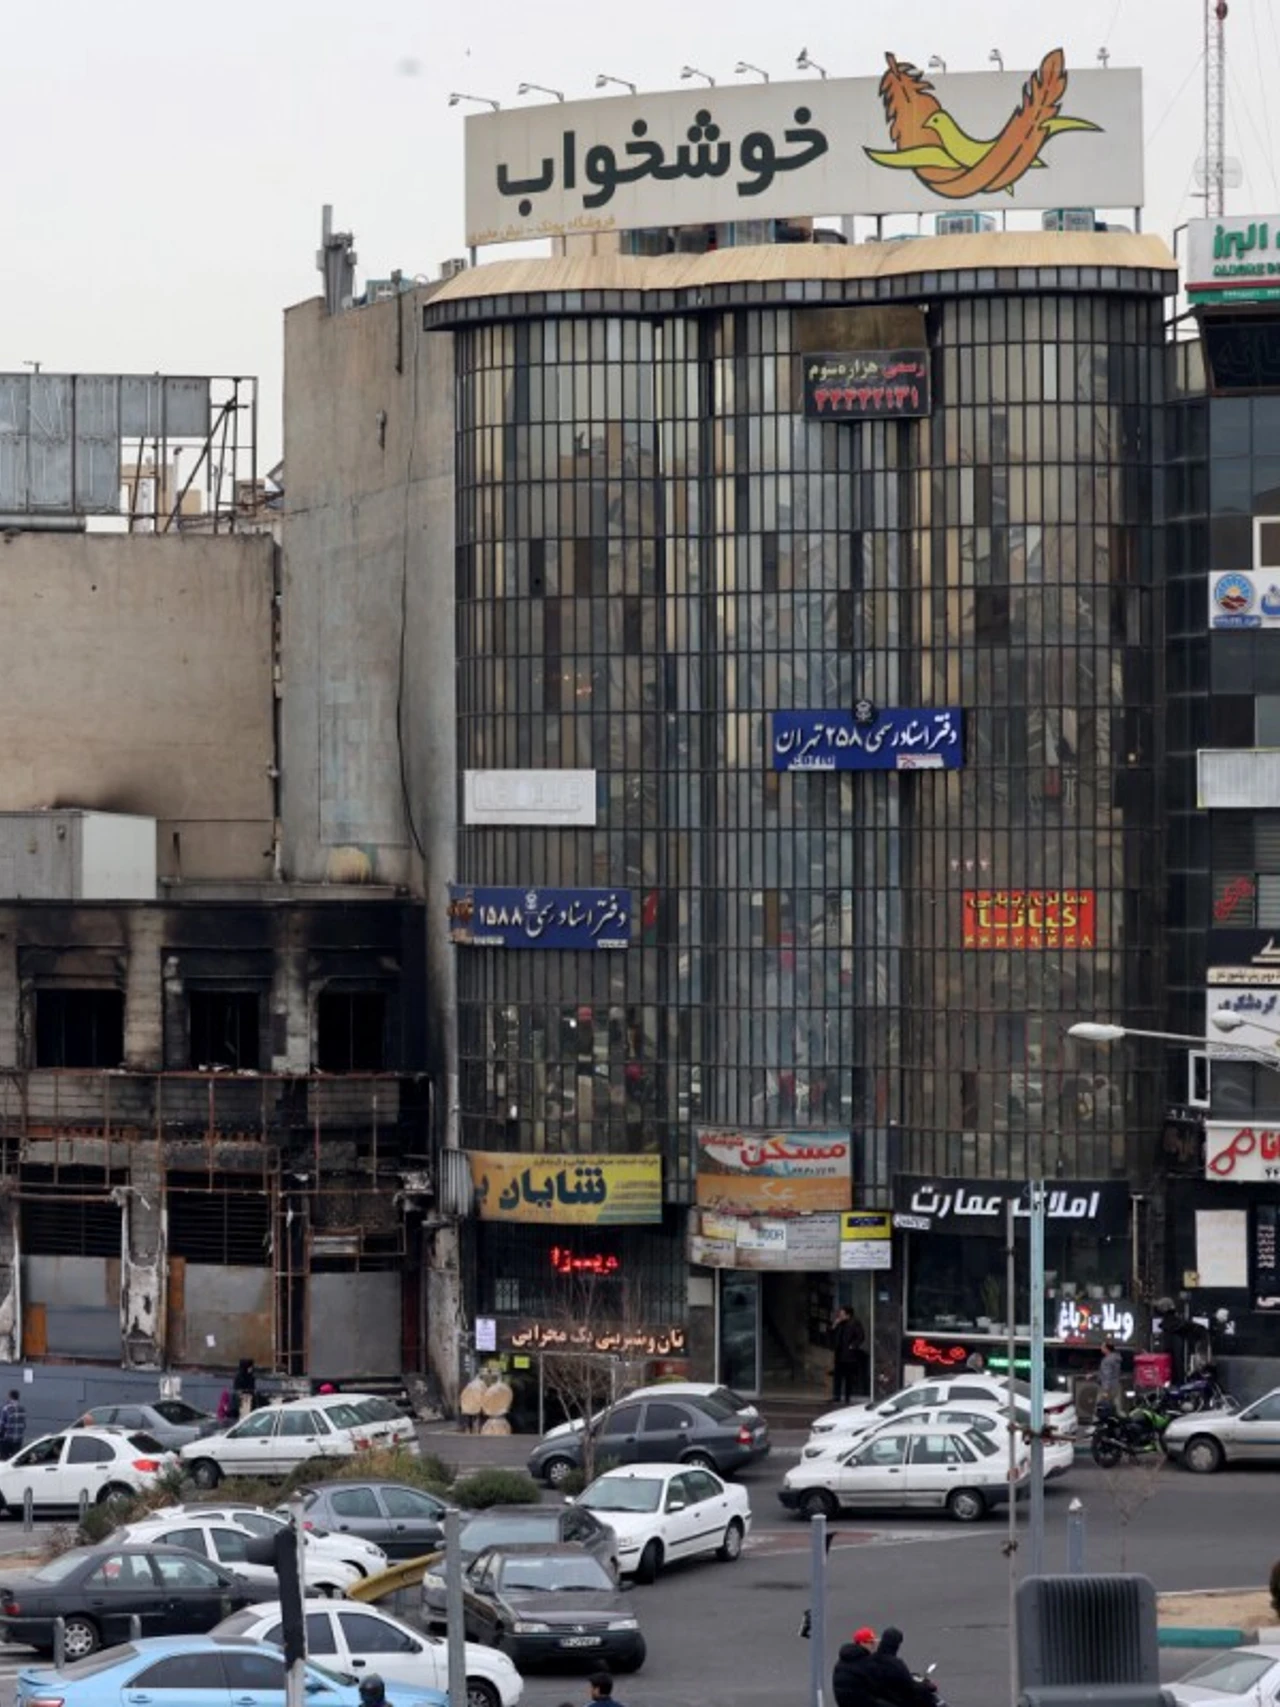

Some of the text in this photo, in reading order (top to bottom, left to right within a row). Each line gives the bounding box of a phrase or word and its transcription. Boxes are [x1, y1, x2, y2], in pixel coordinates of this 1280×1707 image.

[497, 106, 829, 217] خوشخواب
[1213, 223, 1268, 260] البرز
[775, 712, 958, 756] دفتر اسناد رسمی ۲۵۸ تهران
[479, 904, 522, 927] ۱۵۸۸
[525, 902, 556, 938] رسمی
[558, 901, 593, 927] اسناد
[590, 893, 627, 936] دفتر
[740, 1134, 847, 1167] مسکن
[499, 1167, 607, 1210] شایان
[911, 1186, 1100, 1219] املاک عمارت
[594, 1329, 648, 1351] شیرینی
[1101, 1303, 1135, 1342] ویلا
[646, 1336, 656, 1354] و
